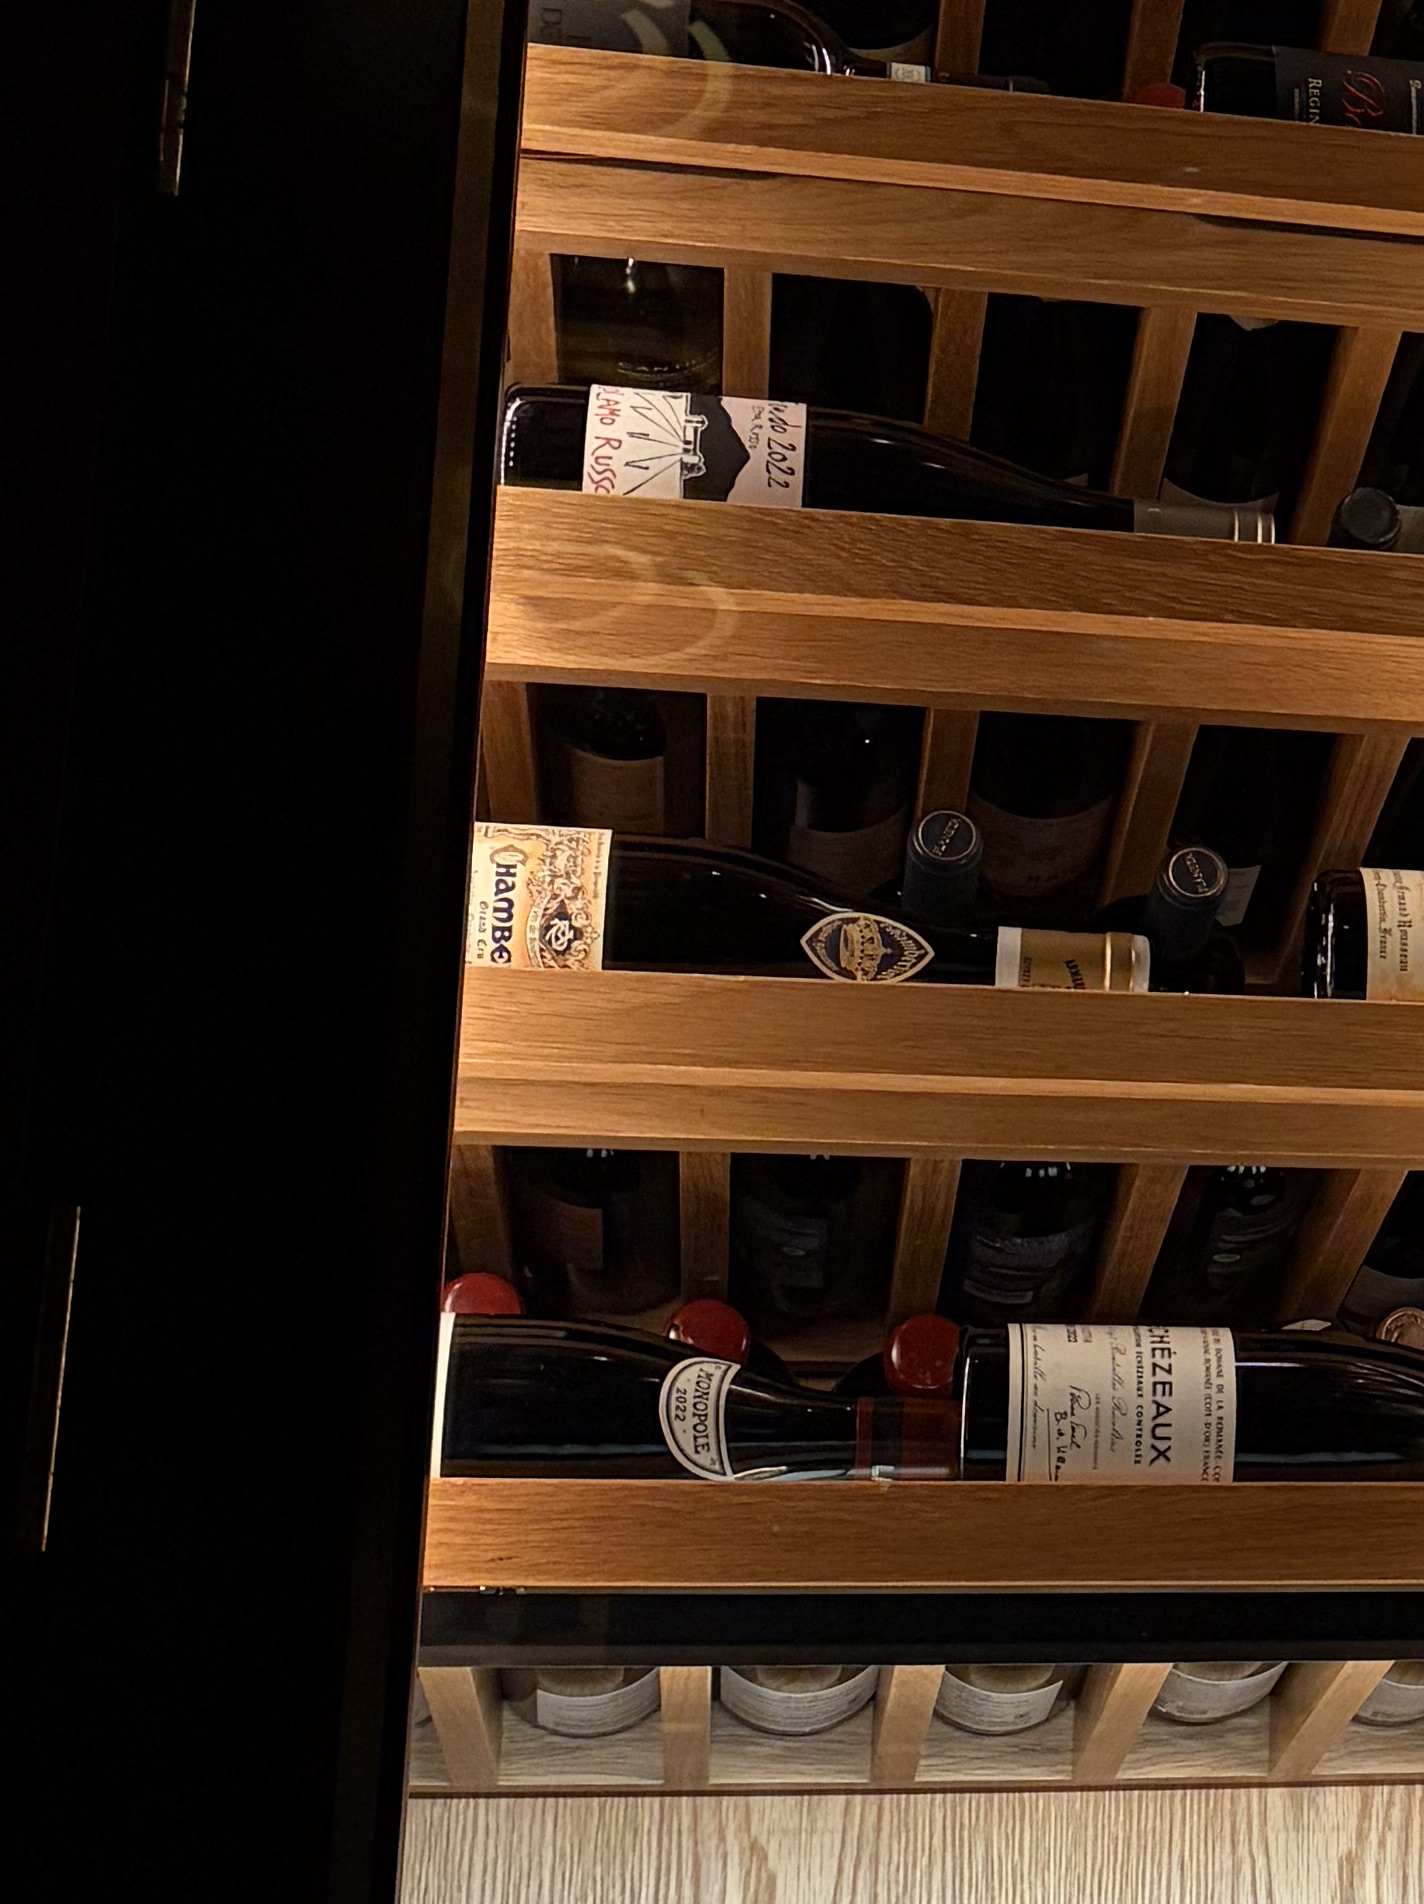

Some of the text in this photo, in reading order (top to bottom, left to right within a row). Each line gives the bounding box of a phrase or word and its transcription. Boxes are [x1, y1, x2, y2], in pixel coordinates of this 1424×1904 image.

[767, 436, 797, 490] 2022
[674, 1386, 688, 1423] 2022
[692, 1367, 715, 1455] MONOPOLE
